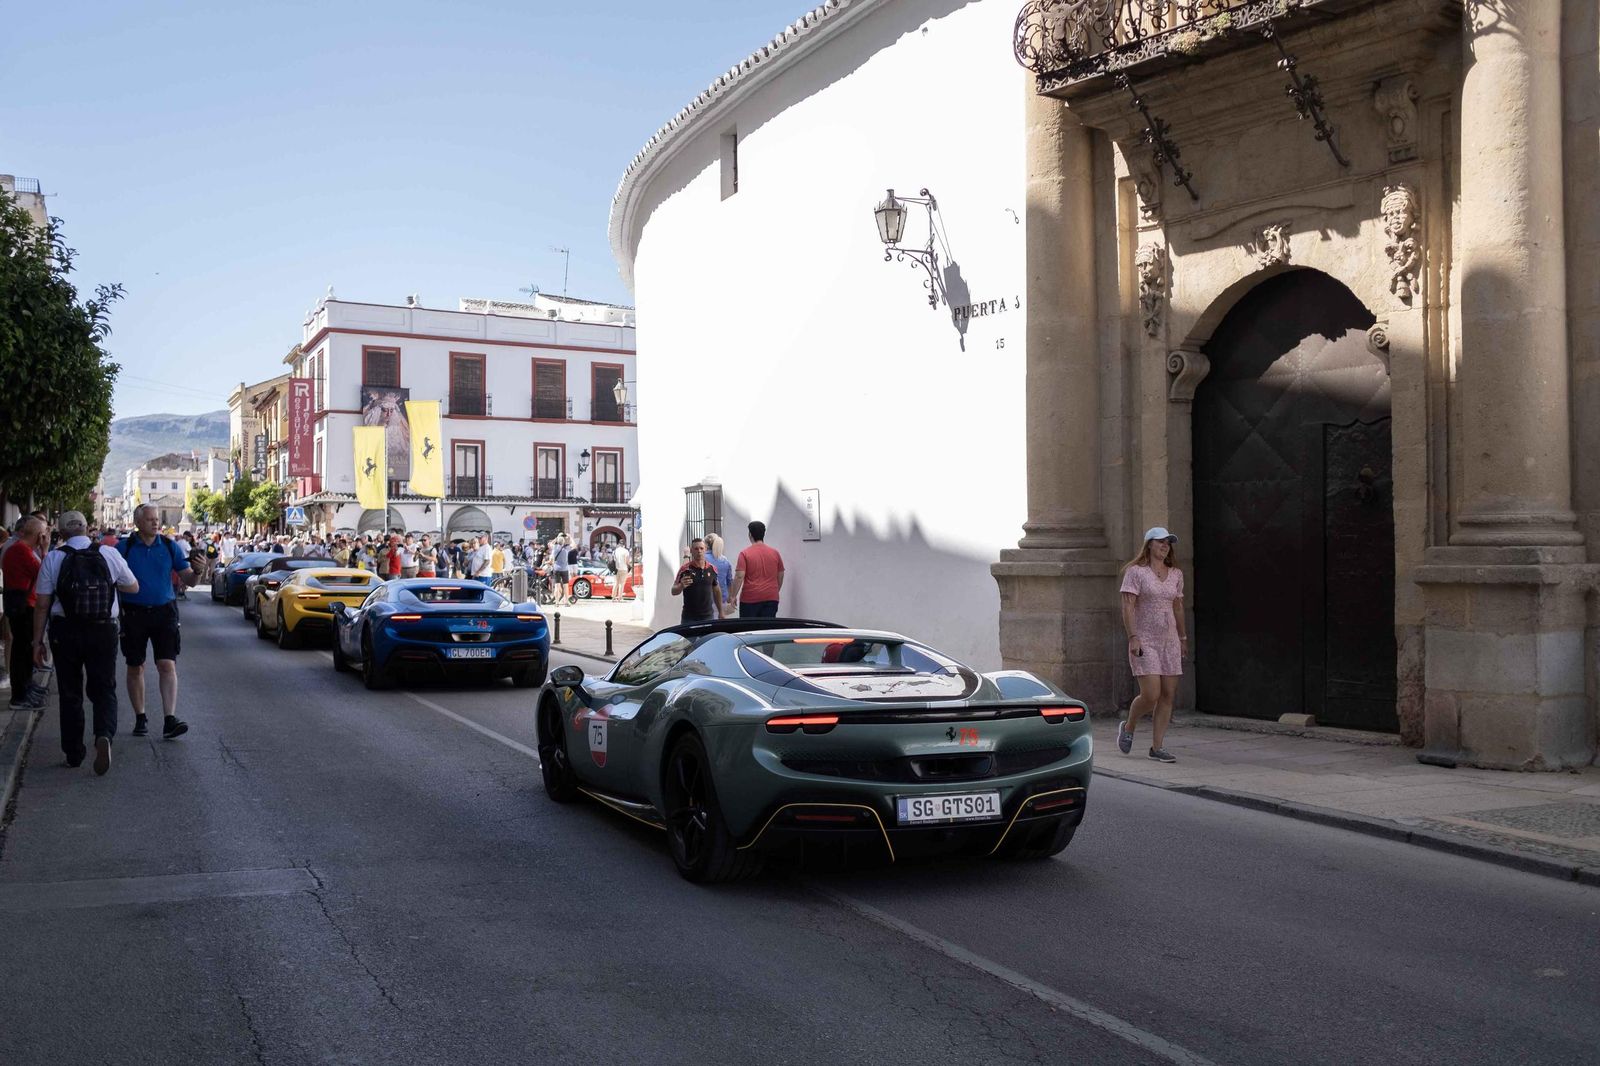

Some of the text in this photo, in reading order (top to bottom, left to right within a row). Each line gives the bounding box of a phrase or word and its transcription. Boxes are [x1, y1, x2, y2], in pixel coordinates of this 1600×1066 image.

[954, 297, 1007, 321] PUERTA
[996, 338, 1005, 350] 15
[592, 725, 603, 745] 75
[959, 728, 978, 746] 75
[913, 796, 995, 817] SG GTS01
